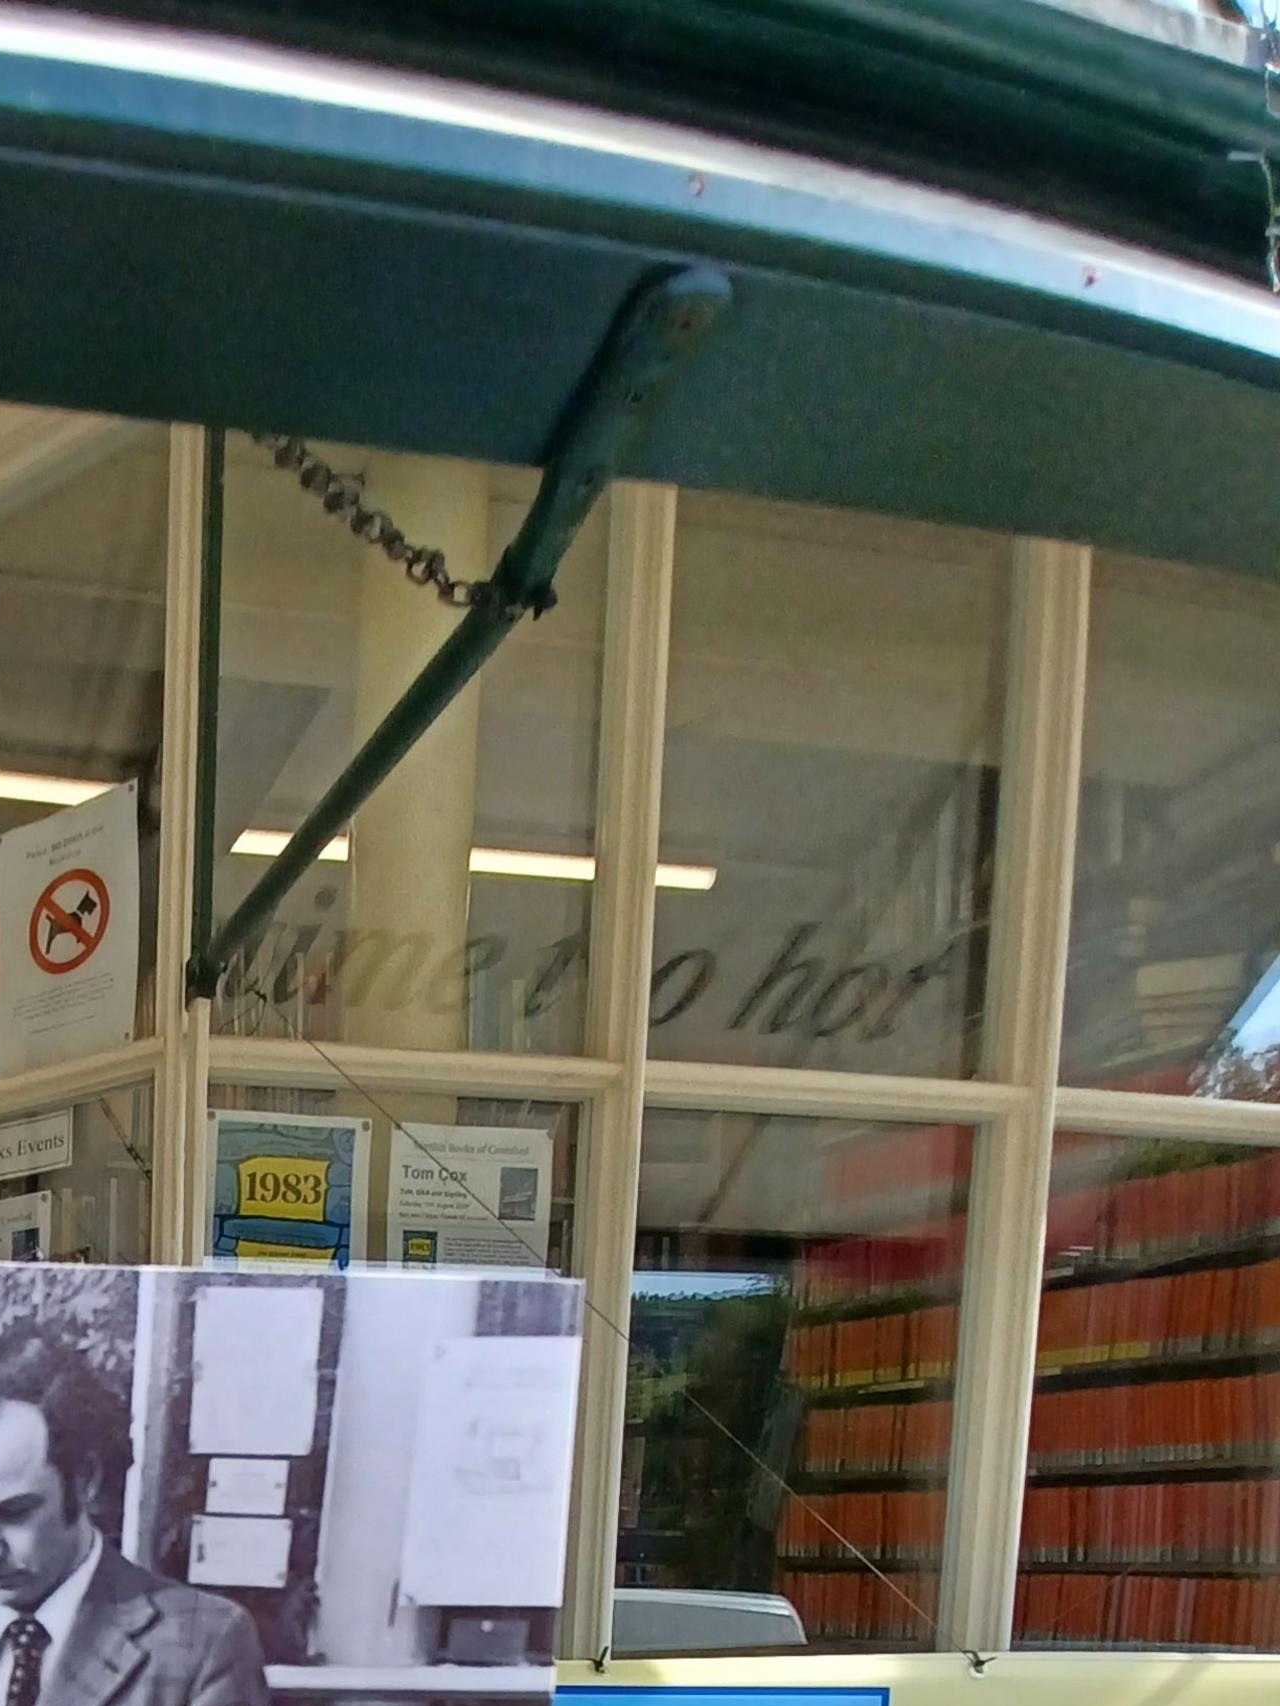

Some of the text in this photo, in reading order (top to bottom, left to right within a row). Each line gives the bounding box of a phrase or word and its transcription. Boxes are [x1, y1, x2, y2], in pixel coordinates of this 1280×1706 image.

[17, 1133, 65, 1157] Events
[402, 1165, 468, 1183] Tom Cox
[245, 1171, 323, 1205] 1983
